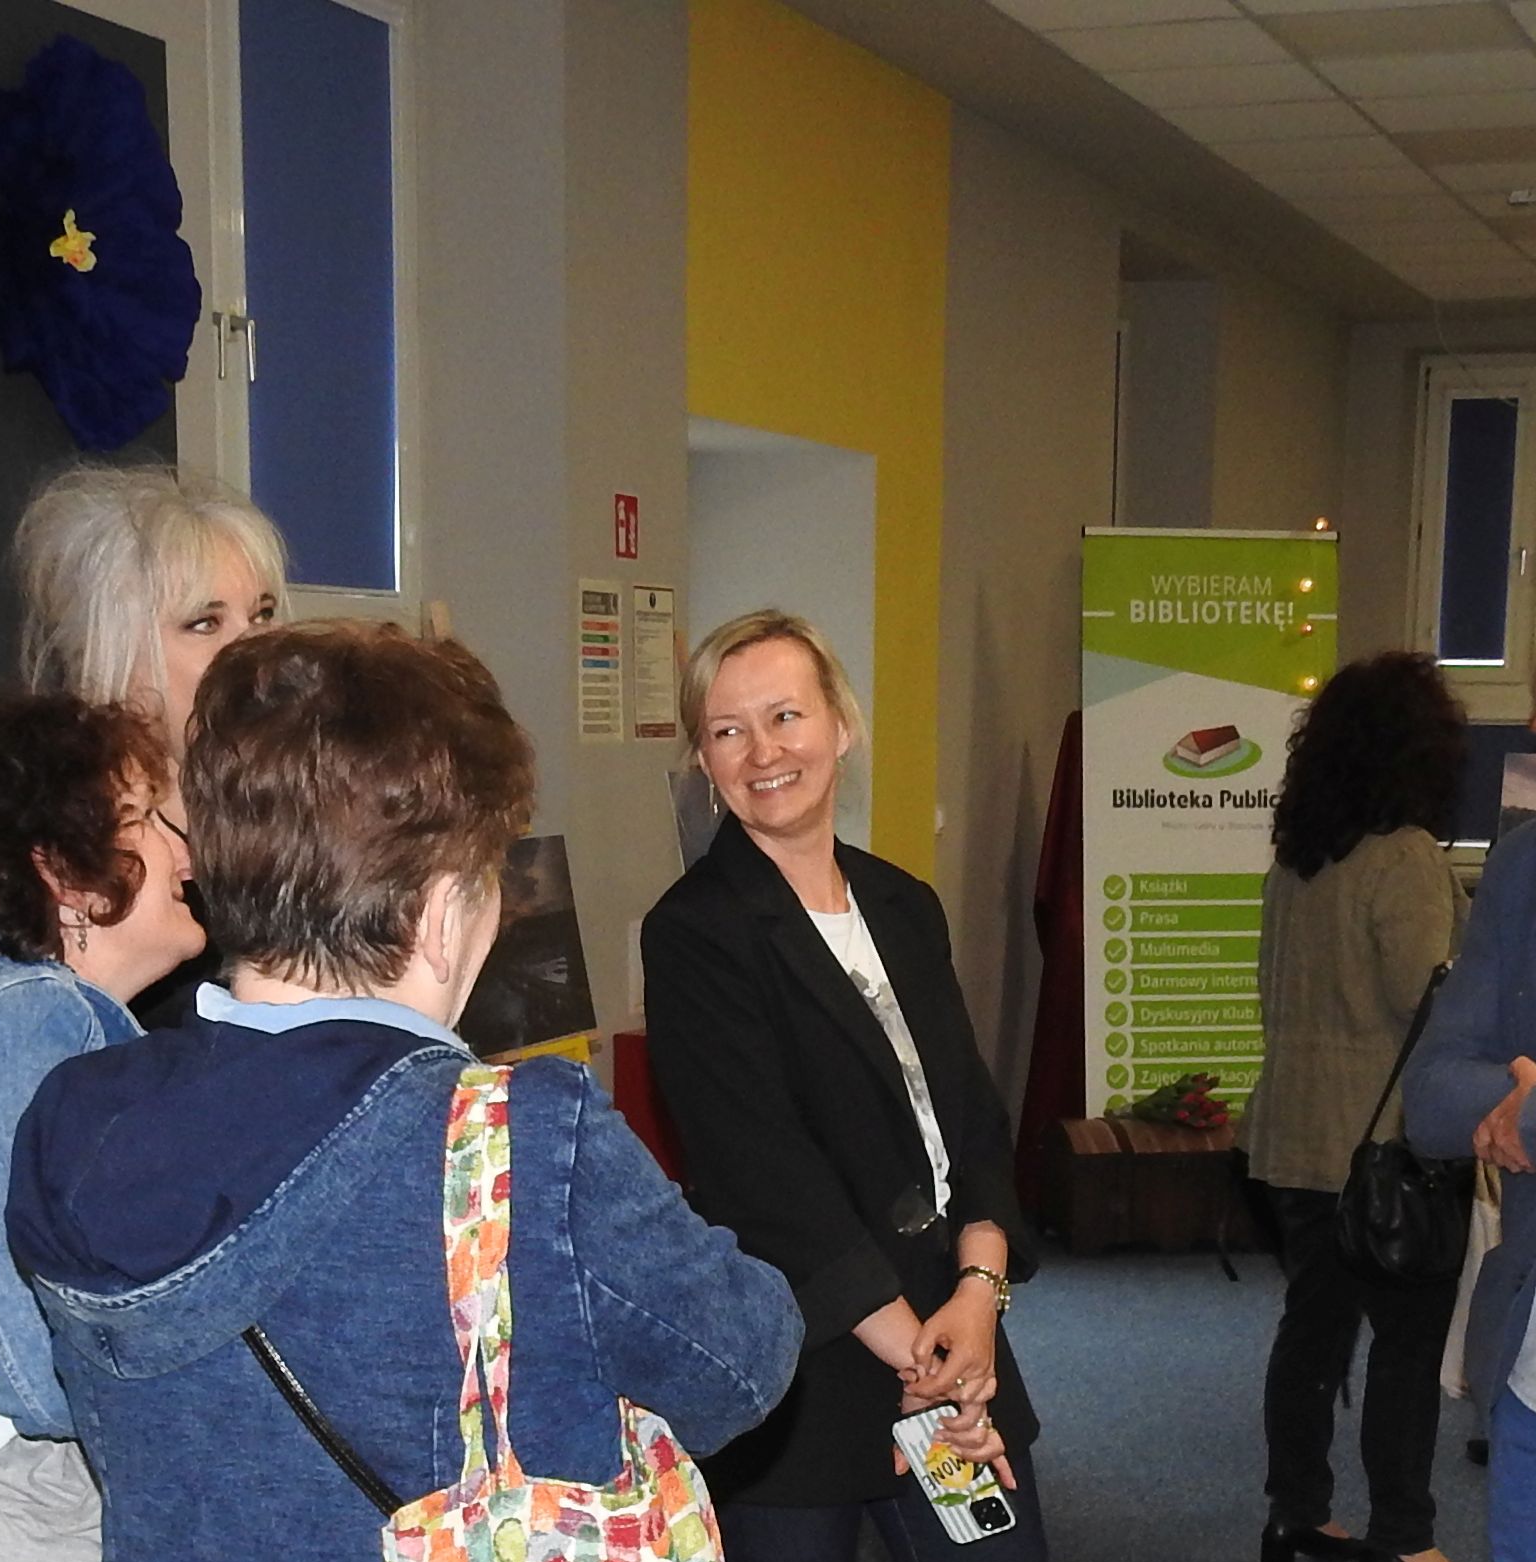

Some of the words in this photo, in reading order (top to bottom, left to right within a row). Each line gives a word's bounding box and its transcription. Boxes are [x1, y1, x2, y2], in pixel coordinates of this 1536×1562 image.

[1151, 575, 1273, 597] WYBIERAM
[1129, 600, 1294, 632] BIBLIOTEKĘ!
[1112, 788, 1213, 810] Biblioteka
[1219, 788, 1281, 809] Public
[1140, 879, 1188, 896] Książki
[1140, 911, 1179, 926] Prasa
[1140, 943, 1220, 957] Multimedia
[1140, 974, 1208, 991] Darmowy
[1212, 973, 1259, 988] intern
[1140, 1007, 1220, 1024] Dyskusyjny
[1223, 1005, 1255, 1019] Klub
[1140, 1038, 1211, 1055] Spotkania
